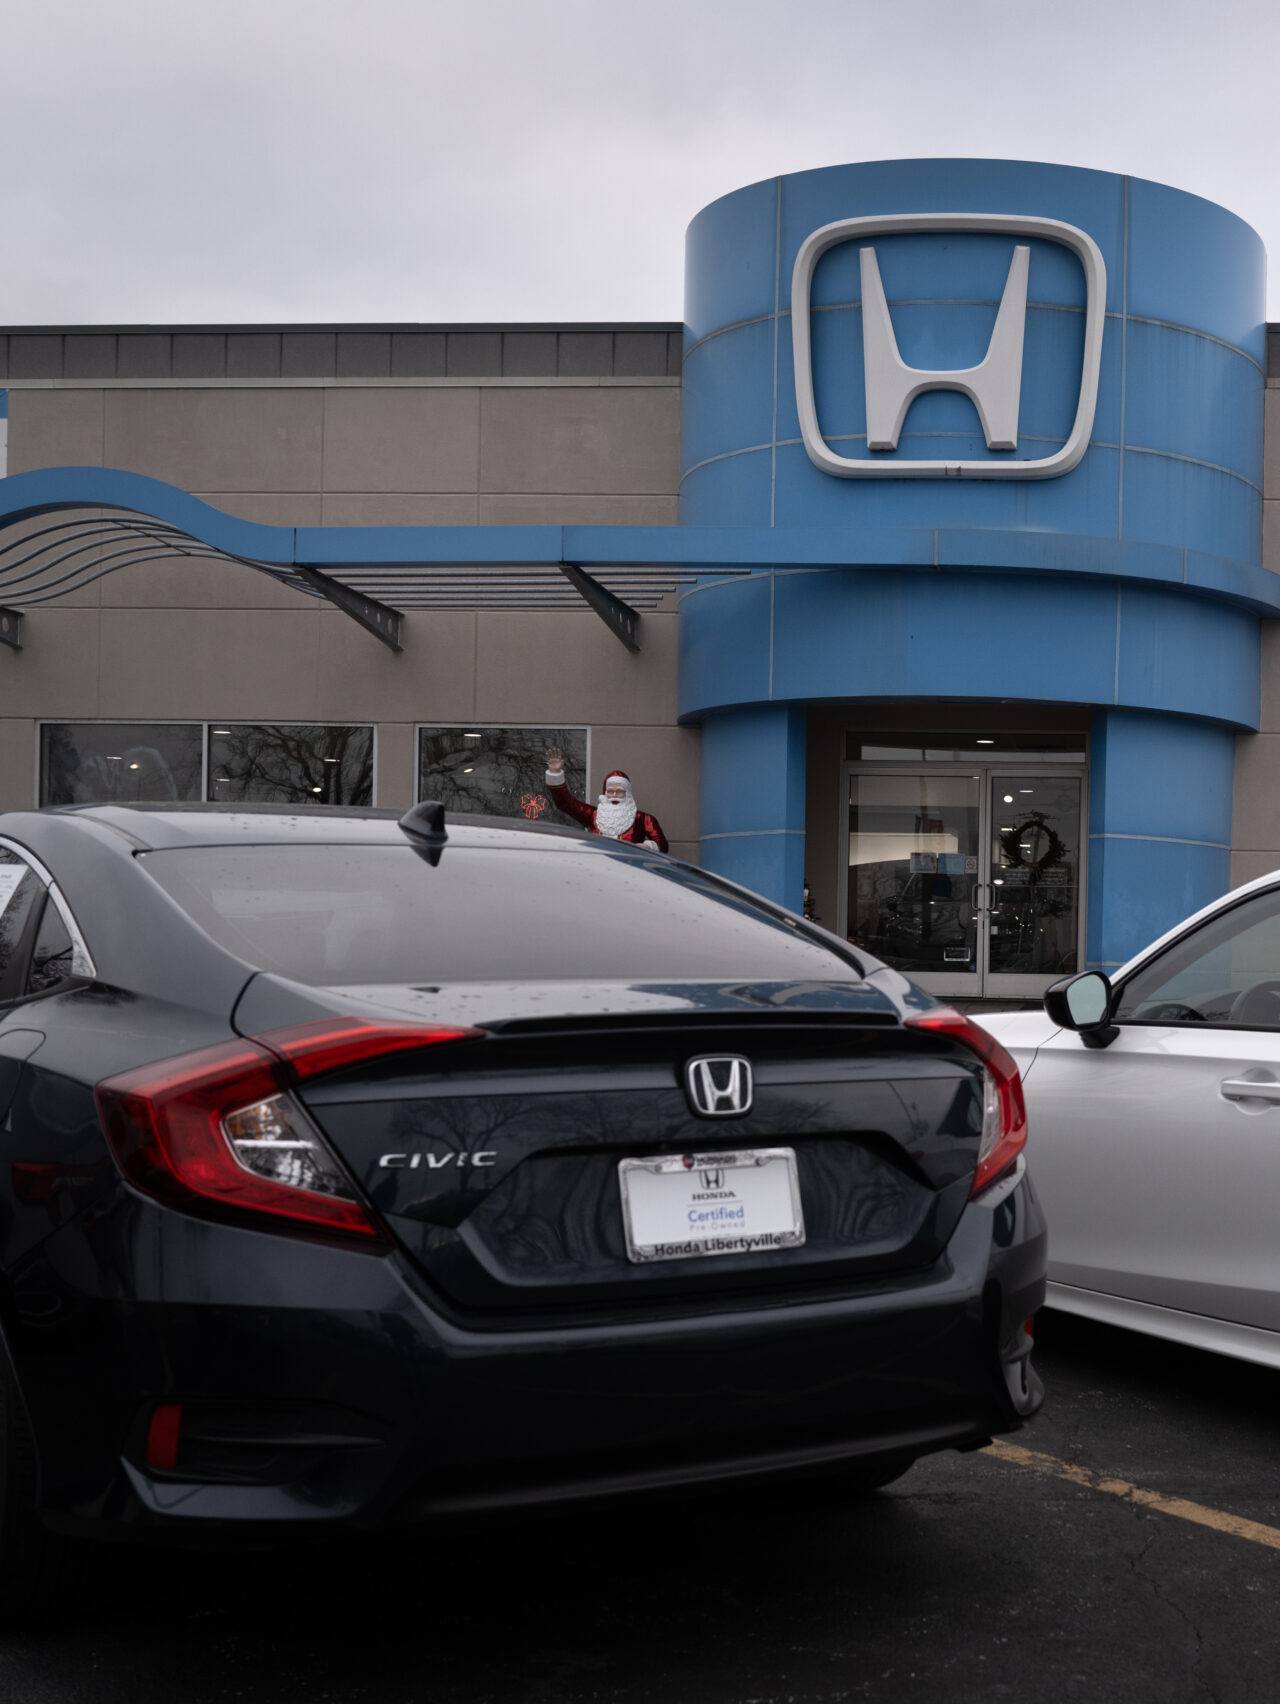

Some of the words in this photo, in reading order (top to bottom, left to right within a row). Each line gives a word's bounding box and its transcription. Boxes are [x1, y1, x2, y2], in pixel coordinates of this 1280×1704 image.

[378, 1151, 498, 1169] CIVIC
[692, 1191, 736, 1200] HONDA
[688, 1207, 744, 1222] Certified
[655, 1244, 700, 1256] Honda
[704, 1233, 782, 1251] Libertyville
